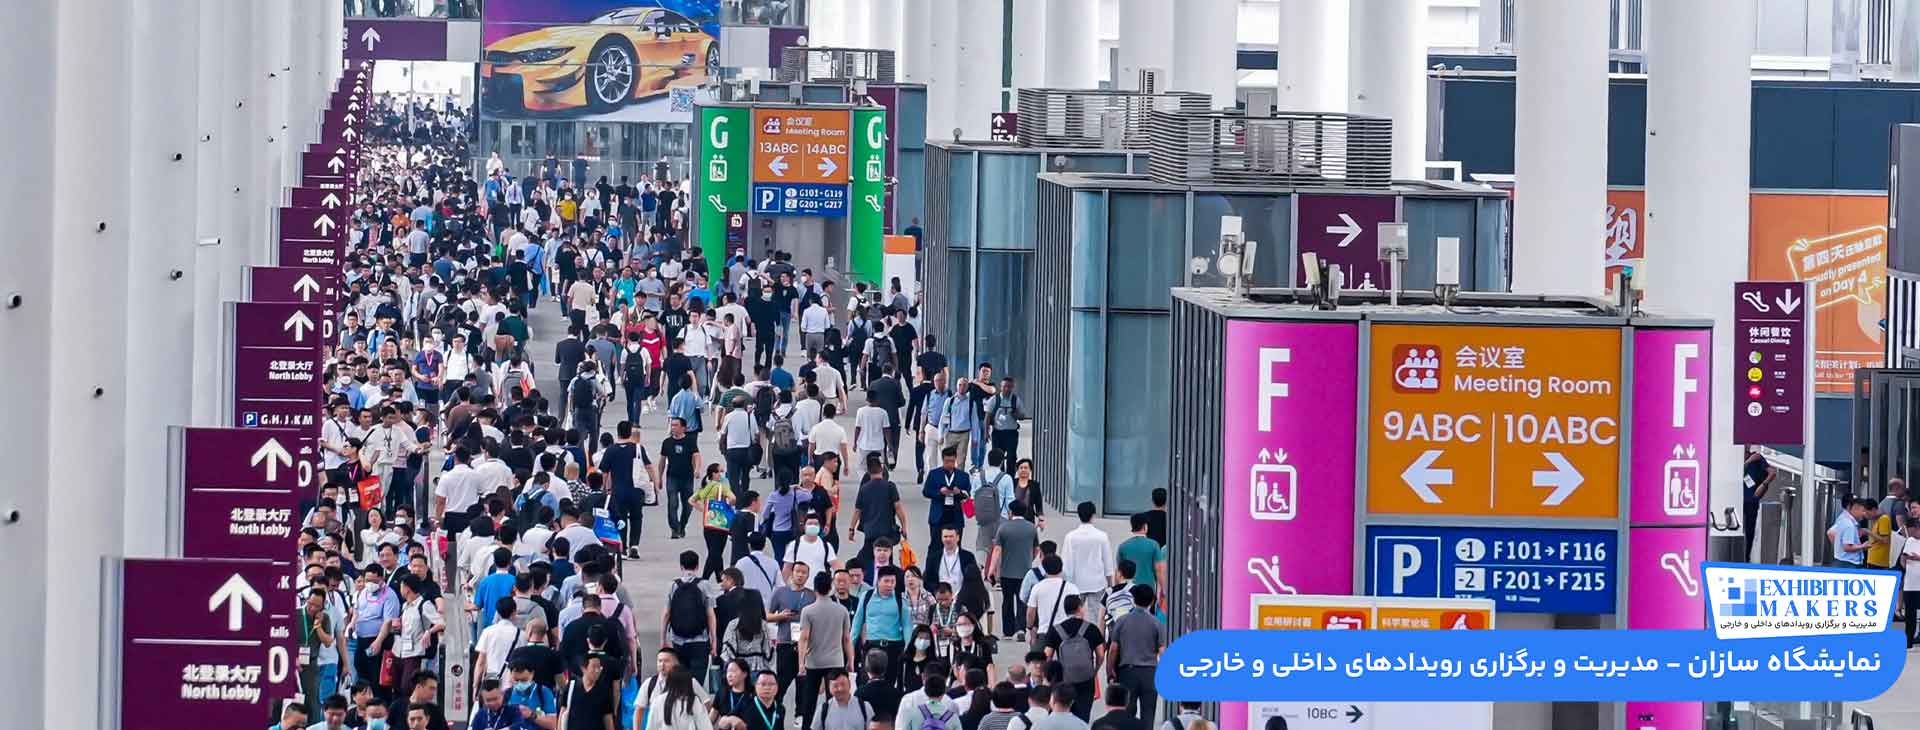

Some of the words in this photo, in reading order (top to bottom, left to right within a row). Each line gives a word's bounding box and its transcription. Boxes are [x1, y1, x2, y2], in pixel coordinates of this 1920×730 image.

[710, 116, 729, 149] G
[867, 116, 883, 149] G
[760, 142, 798, 154] 13ABC
[807, 144, 847, 155] 14ABC
[762, 190, 774, 209] P
[799, 200, 818, 208] G201
[825, 200, 843, 208] G217
[1833, 277, 1855, 293] Day
[1858, 270, 1868, 283] 4
[1455, 345, 1526, 369] 会议室
[1258, 347, 1291, 432] F
[1455, 374, 1542, 399] Meeting
[1548, 376, 1612, 395] Room
[1673, 343, 1699, 428] F
[246, 414, 254, 425] P
[1383, 410, 1482, 443] 9ABC
[1503, 413, 1617, 445] 10ABC
[229, 522, 260, 535] North
[261, 523, 291, 538] Lobby
[1393, 543, 1422, 594] P
[182, 663, 262, 683] 北登录大厅
[181, 683, 219, 700] North
[221, 683, 261, 704] Lobby
